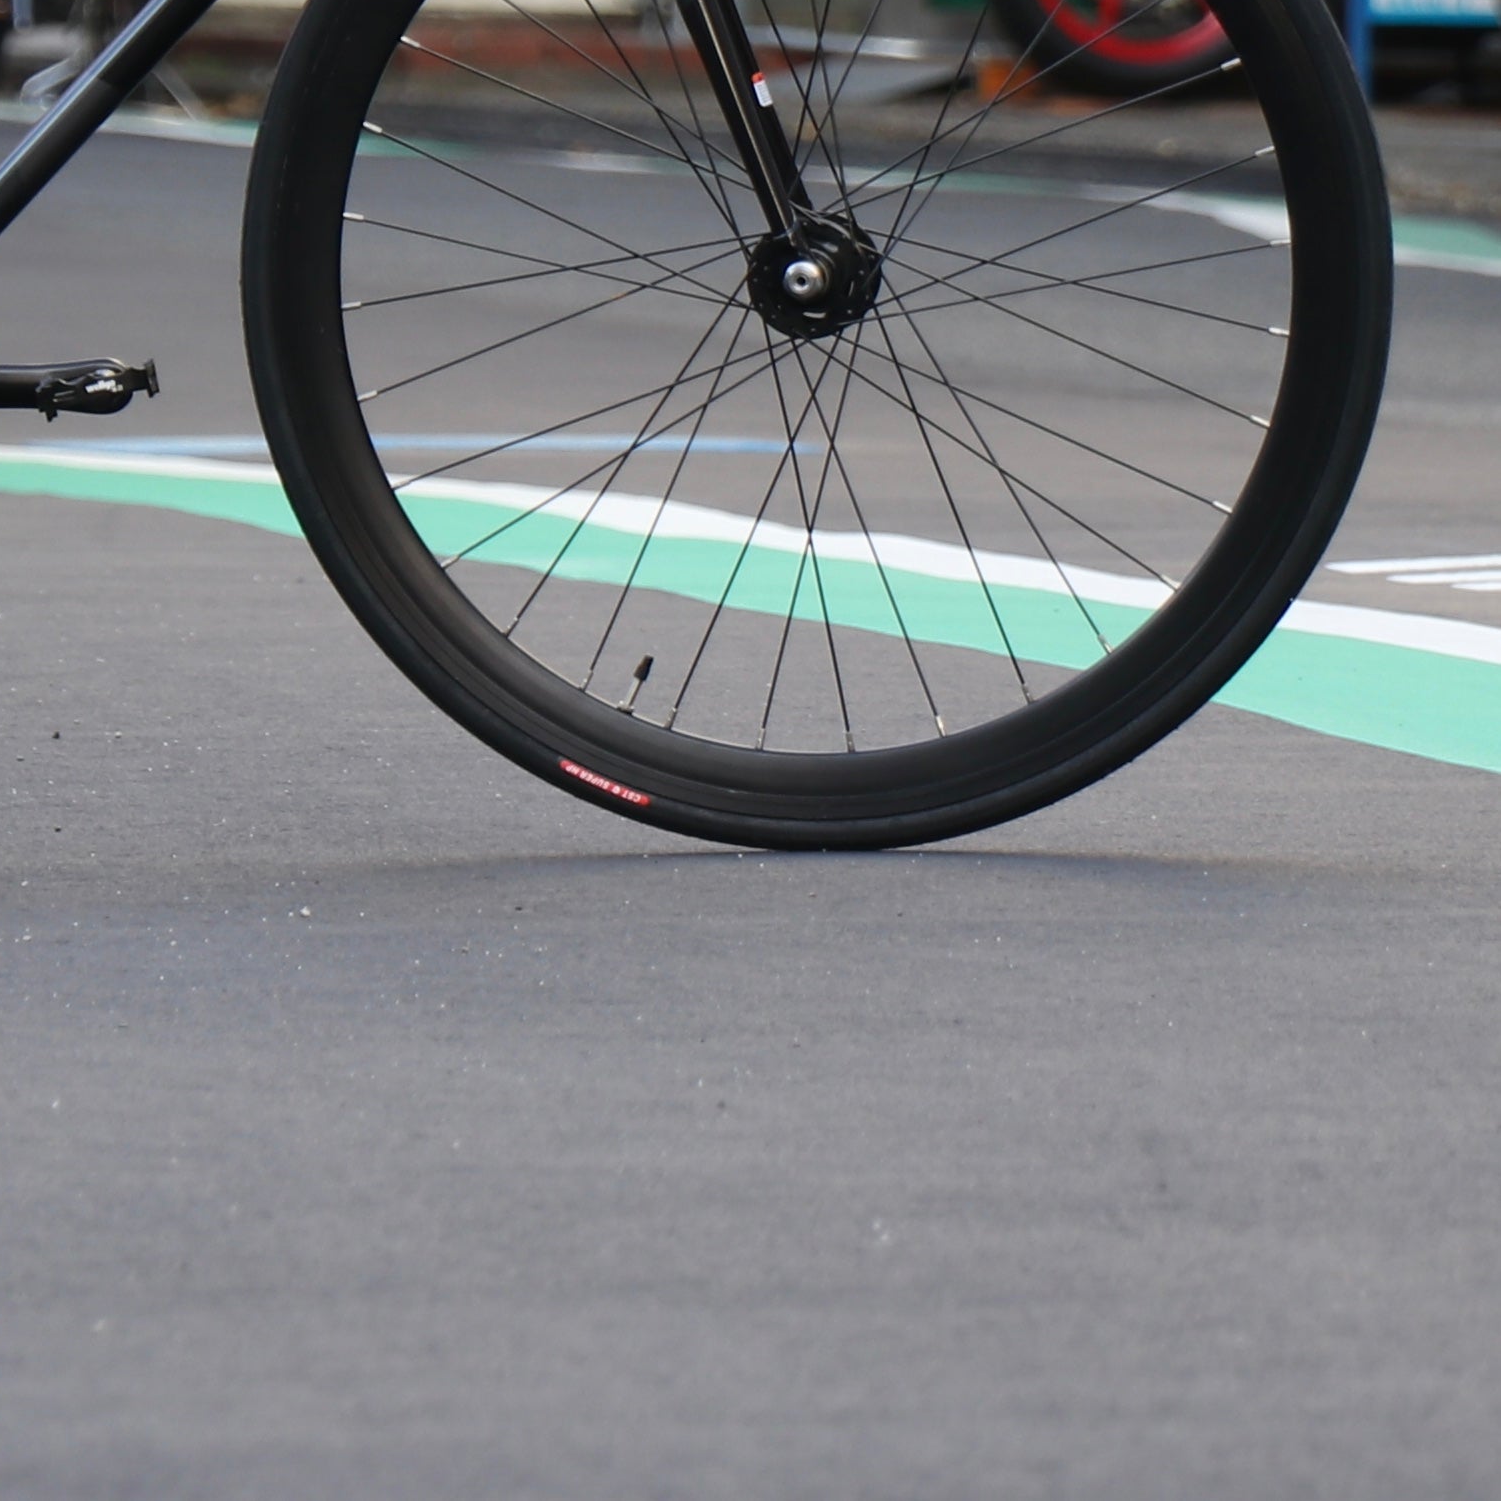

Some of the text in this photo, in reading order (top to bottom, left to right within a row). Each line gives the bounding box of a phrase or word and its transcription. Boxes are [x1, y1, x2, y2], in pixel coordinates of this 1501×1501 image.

[565, 764, 642, 803] CST SUPER HP
